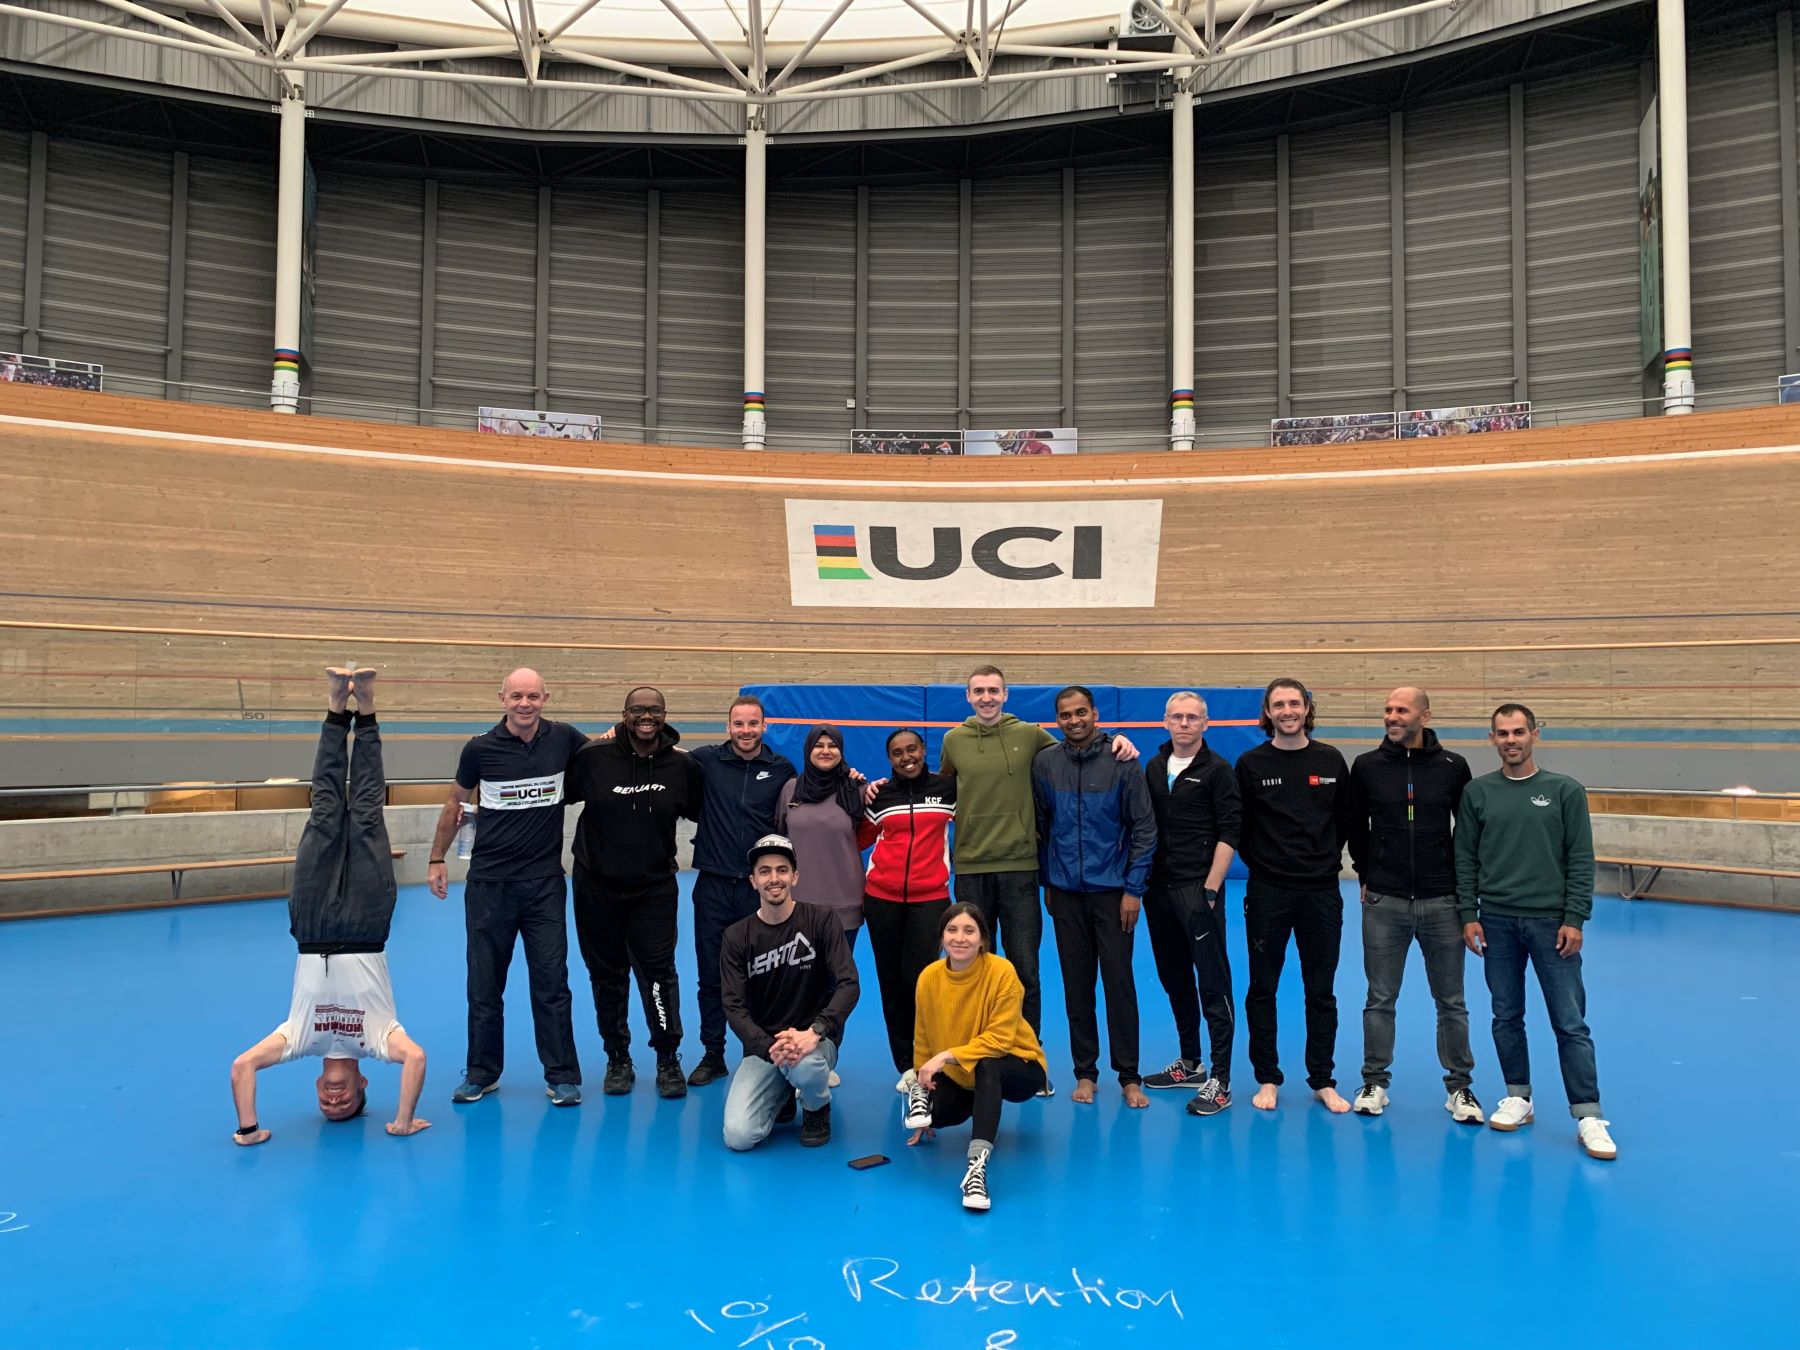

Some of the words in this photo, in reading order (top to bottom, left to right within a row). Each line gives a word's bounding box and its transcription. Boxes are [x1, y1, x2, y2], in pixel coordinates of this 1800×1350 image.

[869, 525, 1102, 581] UCI
[244, 711, 265, 720] 50
[517, 787, 542, 800] UCI
[612, 783, 667, 795] BENJART
[924, 796, 943, 805] KCF
[652, 981, 667, 1031] BENJART
[842, 1257, 1184, 1320] Retention
